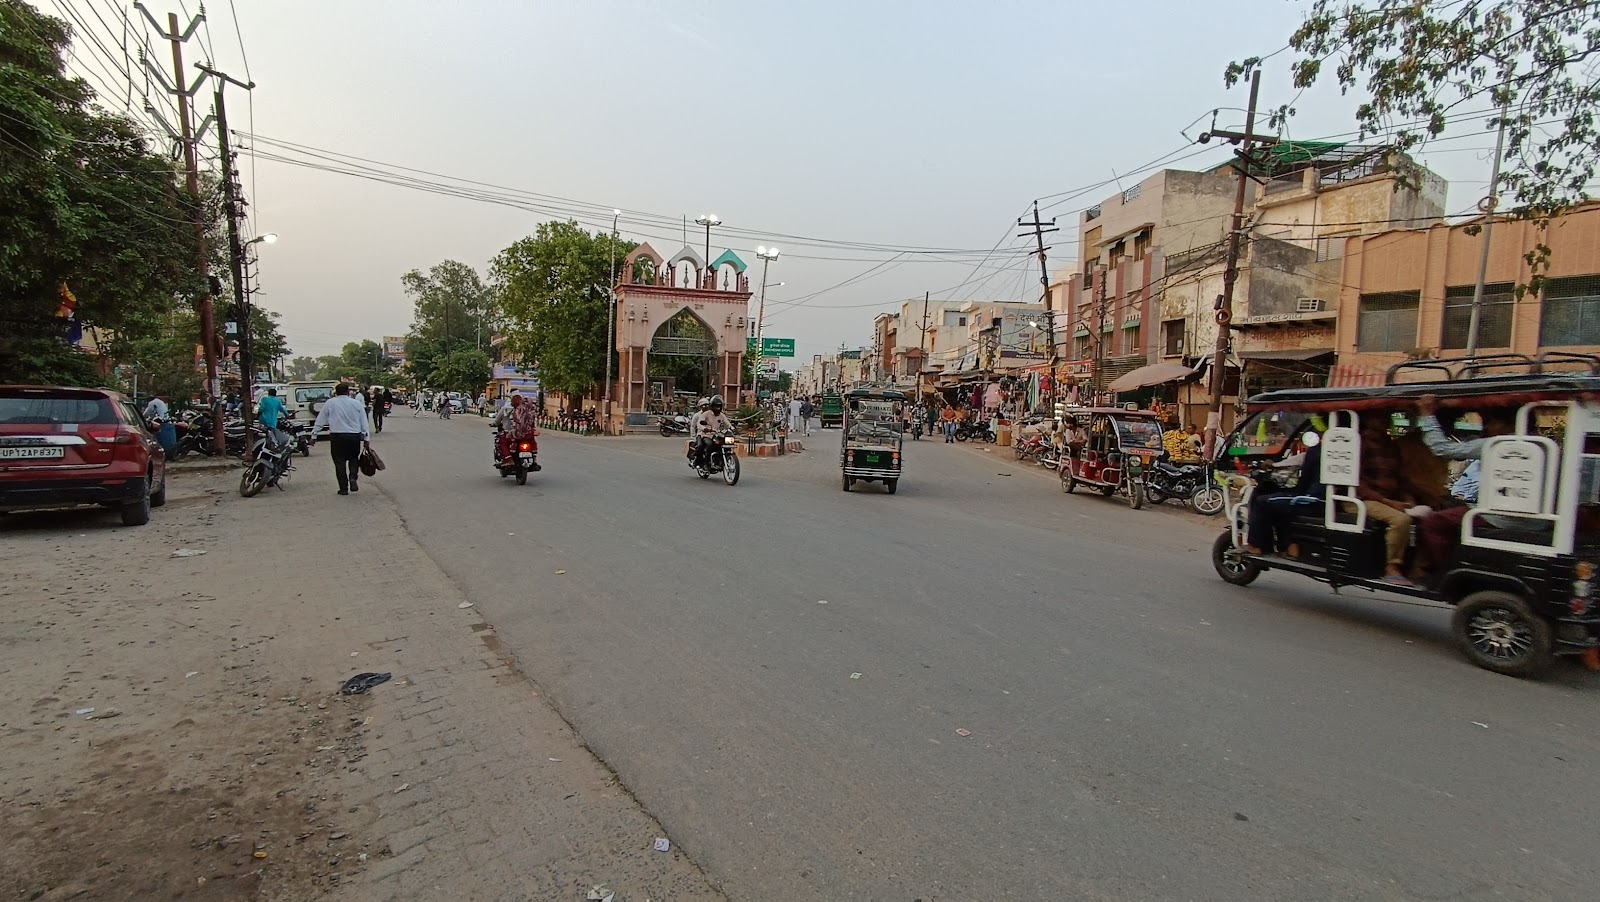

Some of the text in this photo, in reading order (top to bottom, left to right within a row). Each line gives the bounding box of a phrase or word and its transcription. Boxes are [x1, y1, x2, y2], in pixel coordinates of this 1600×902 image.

[2, 448, 62, 457] UP12AP8371
[1326, 450, 1352, 460] ROAD
[1493, 469, 1534, 481] ROAD
